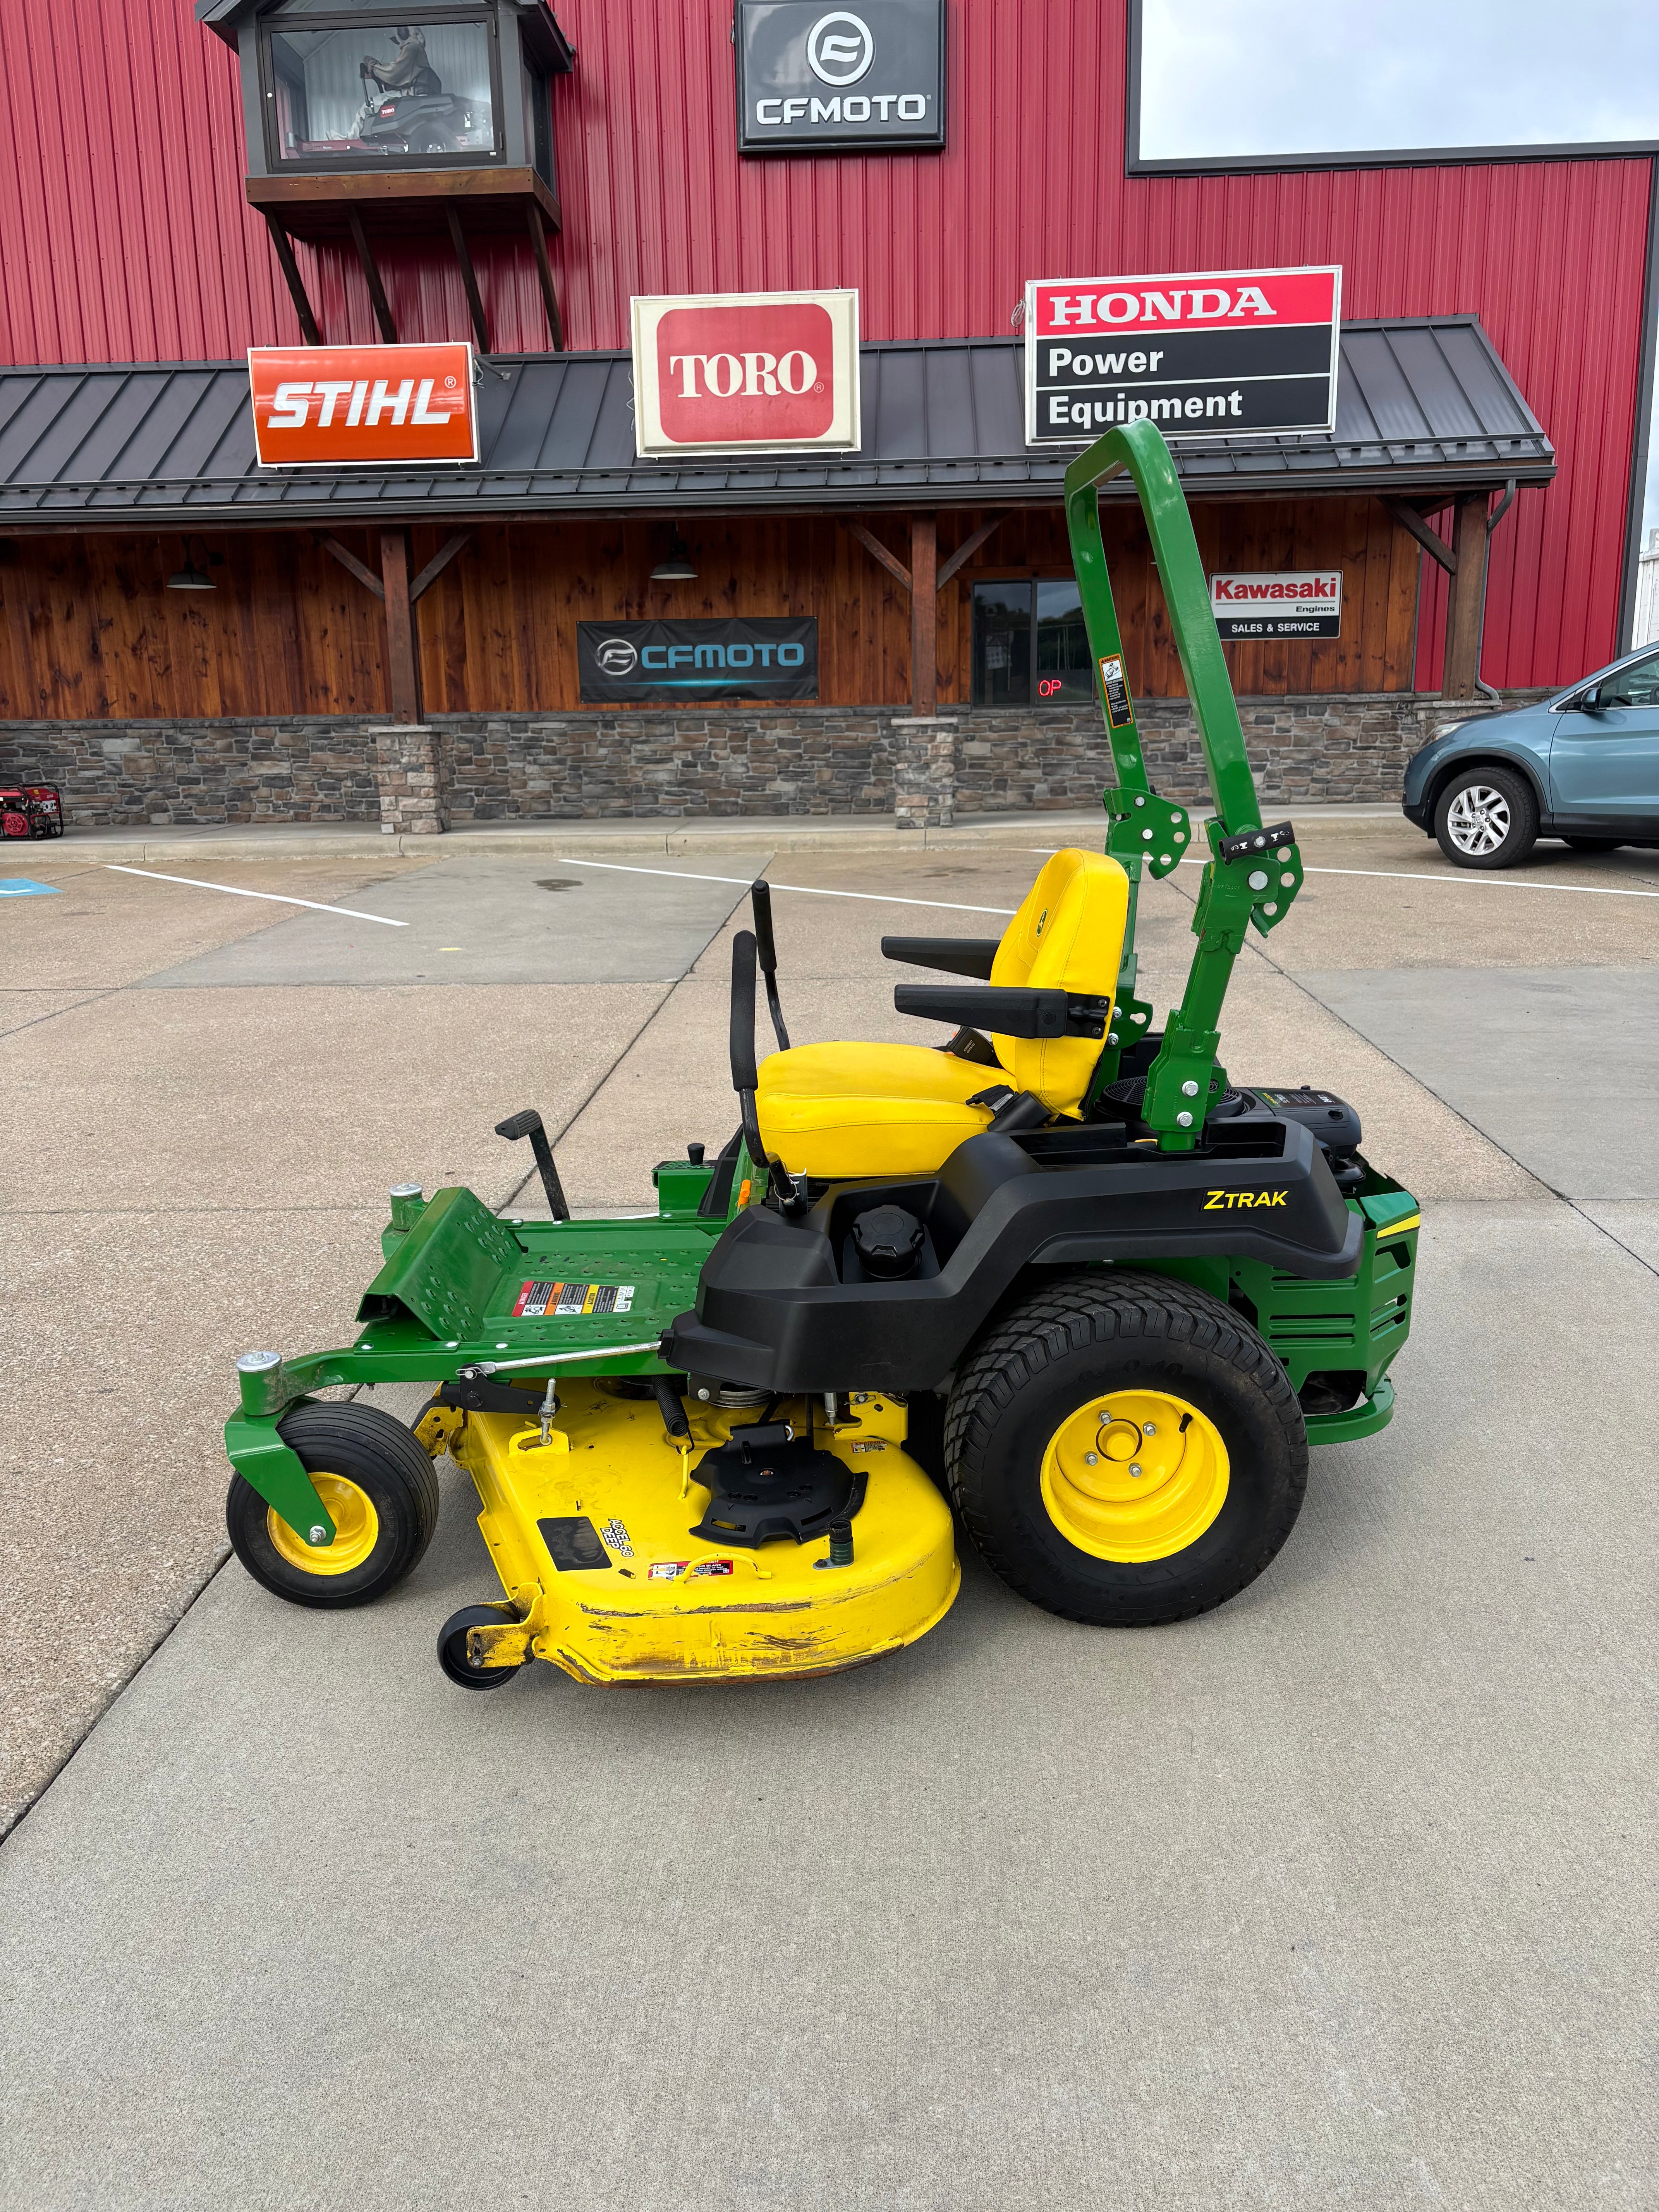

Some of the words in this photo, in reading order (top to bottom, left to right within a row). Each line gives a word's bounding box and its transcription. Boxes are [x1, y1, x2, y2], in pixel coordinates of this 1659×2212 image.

[756, 94, 926, 125] CFMOTO
[1049, 287, 1277, 326] HONDA
[670, 350, 817, 398] TORO
[1049, 348, 1164, 377] Power
[267, 378, 451, 428] STIHL
[1049, 390, 1243, 429] Equipment
[1215, 577, 1336, 600] Kawasaki
[1231, 624, 1263, 633] SALES
[1267, 624, 1274, 632] &
[1278, 623, 1320, 632] SERVICE
[641, 643, 804, 669] CFMOTO
[1203, 1190, 1289, 1210] ZTRAK
[599, 1527, 620, 1549] DEEP
[607, 1518, 631, 1545] ACCEL
[620, 1545, 635, 1557] 60
